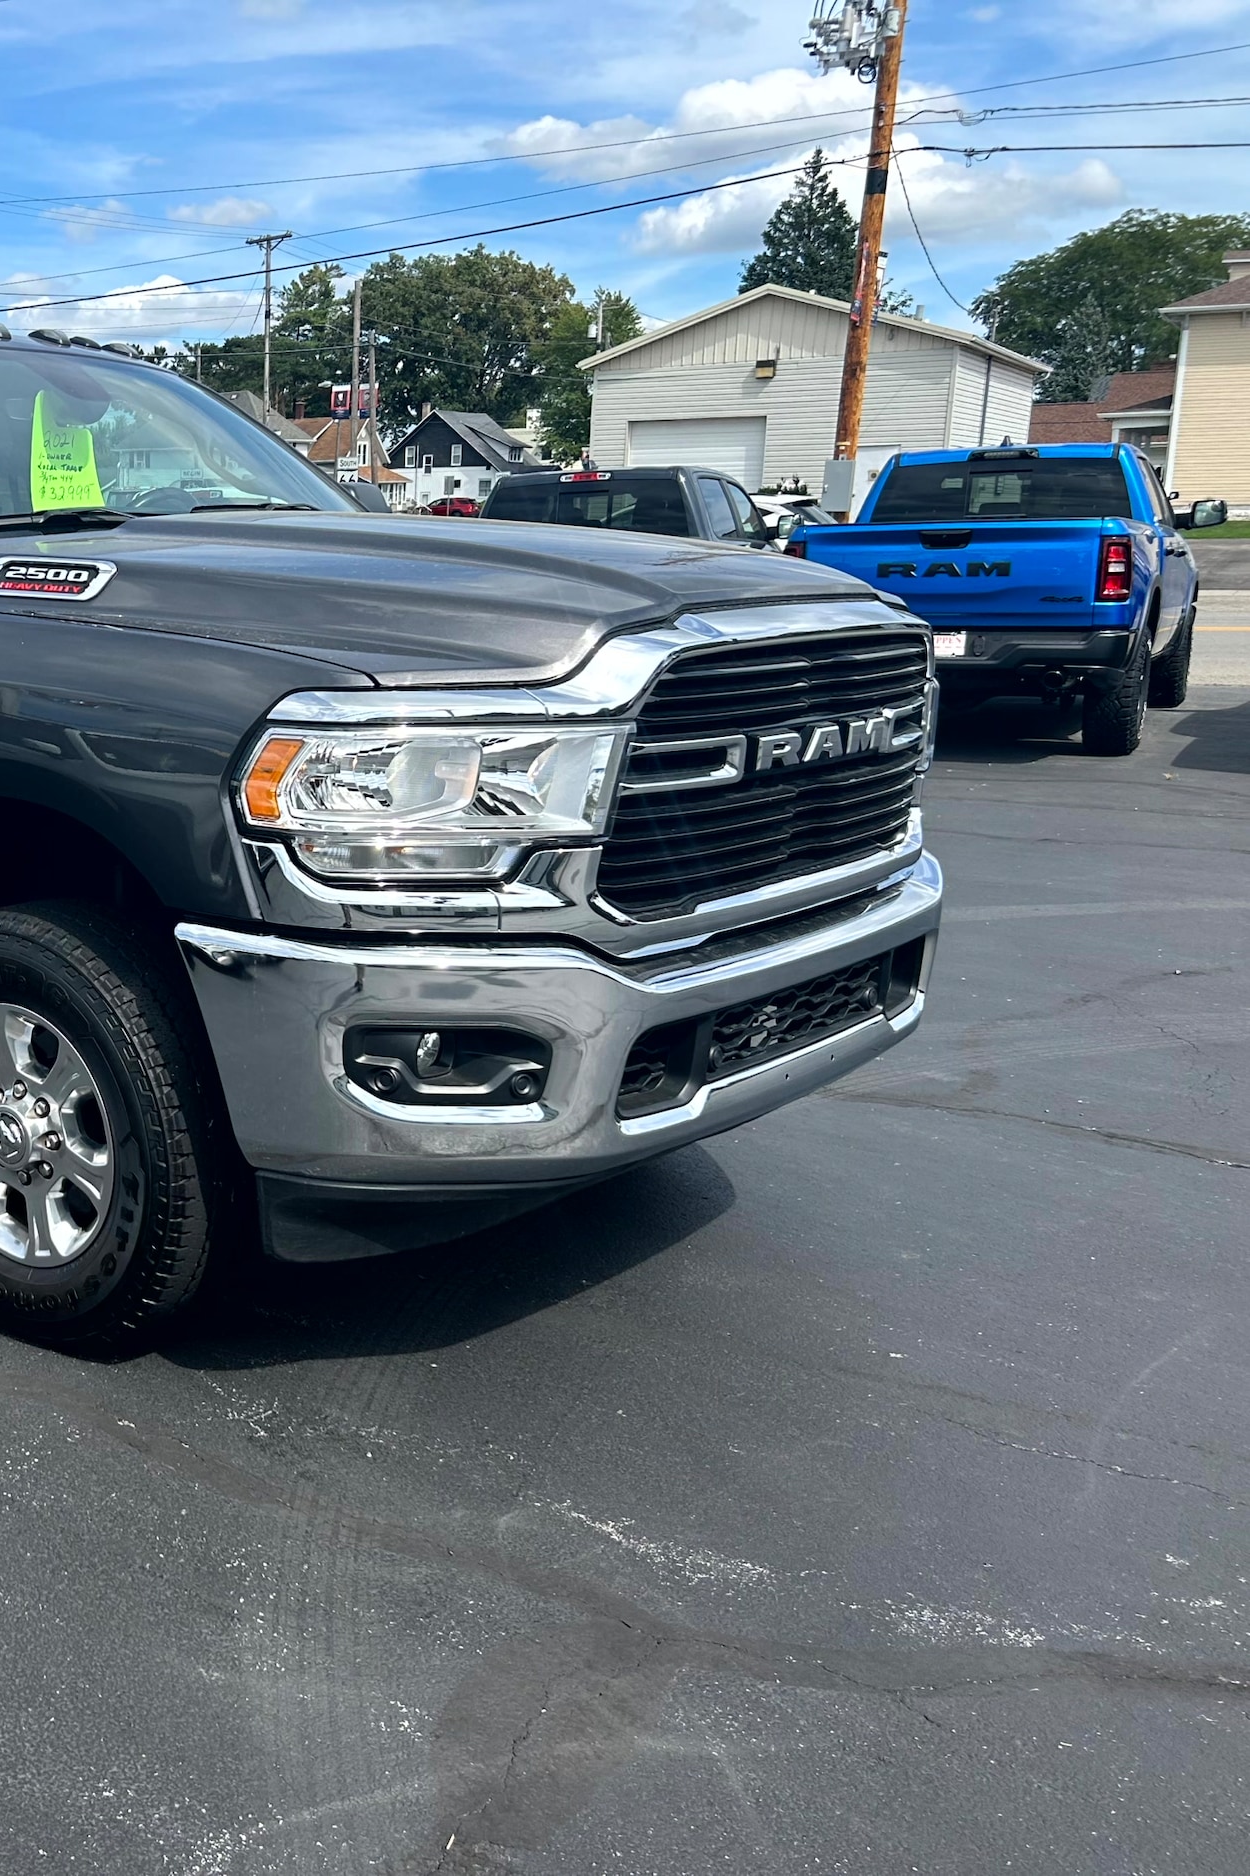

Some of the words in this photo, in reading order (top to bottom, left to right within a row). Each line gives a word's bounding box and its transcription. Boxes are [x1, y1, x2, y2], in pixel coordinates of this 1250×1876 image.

[44, 430, 75, 449] 2021
[340, 460, 357, 468] SOUTH
[5, 566, 90, 582] 2500
[876, 561, 1012, 578] RAM
[43, 583, 83, 594] DUTY
[755, 715, 886, 771] RAM
